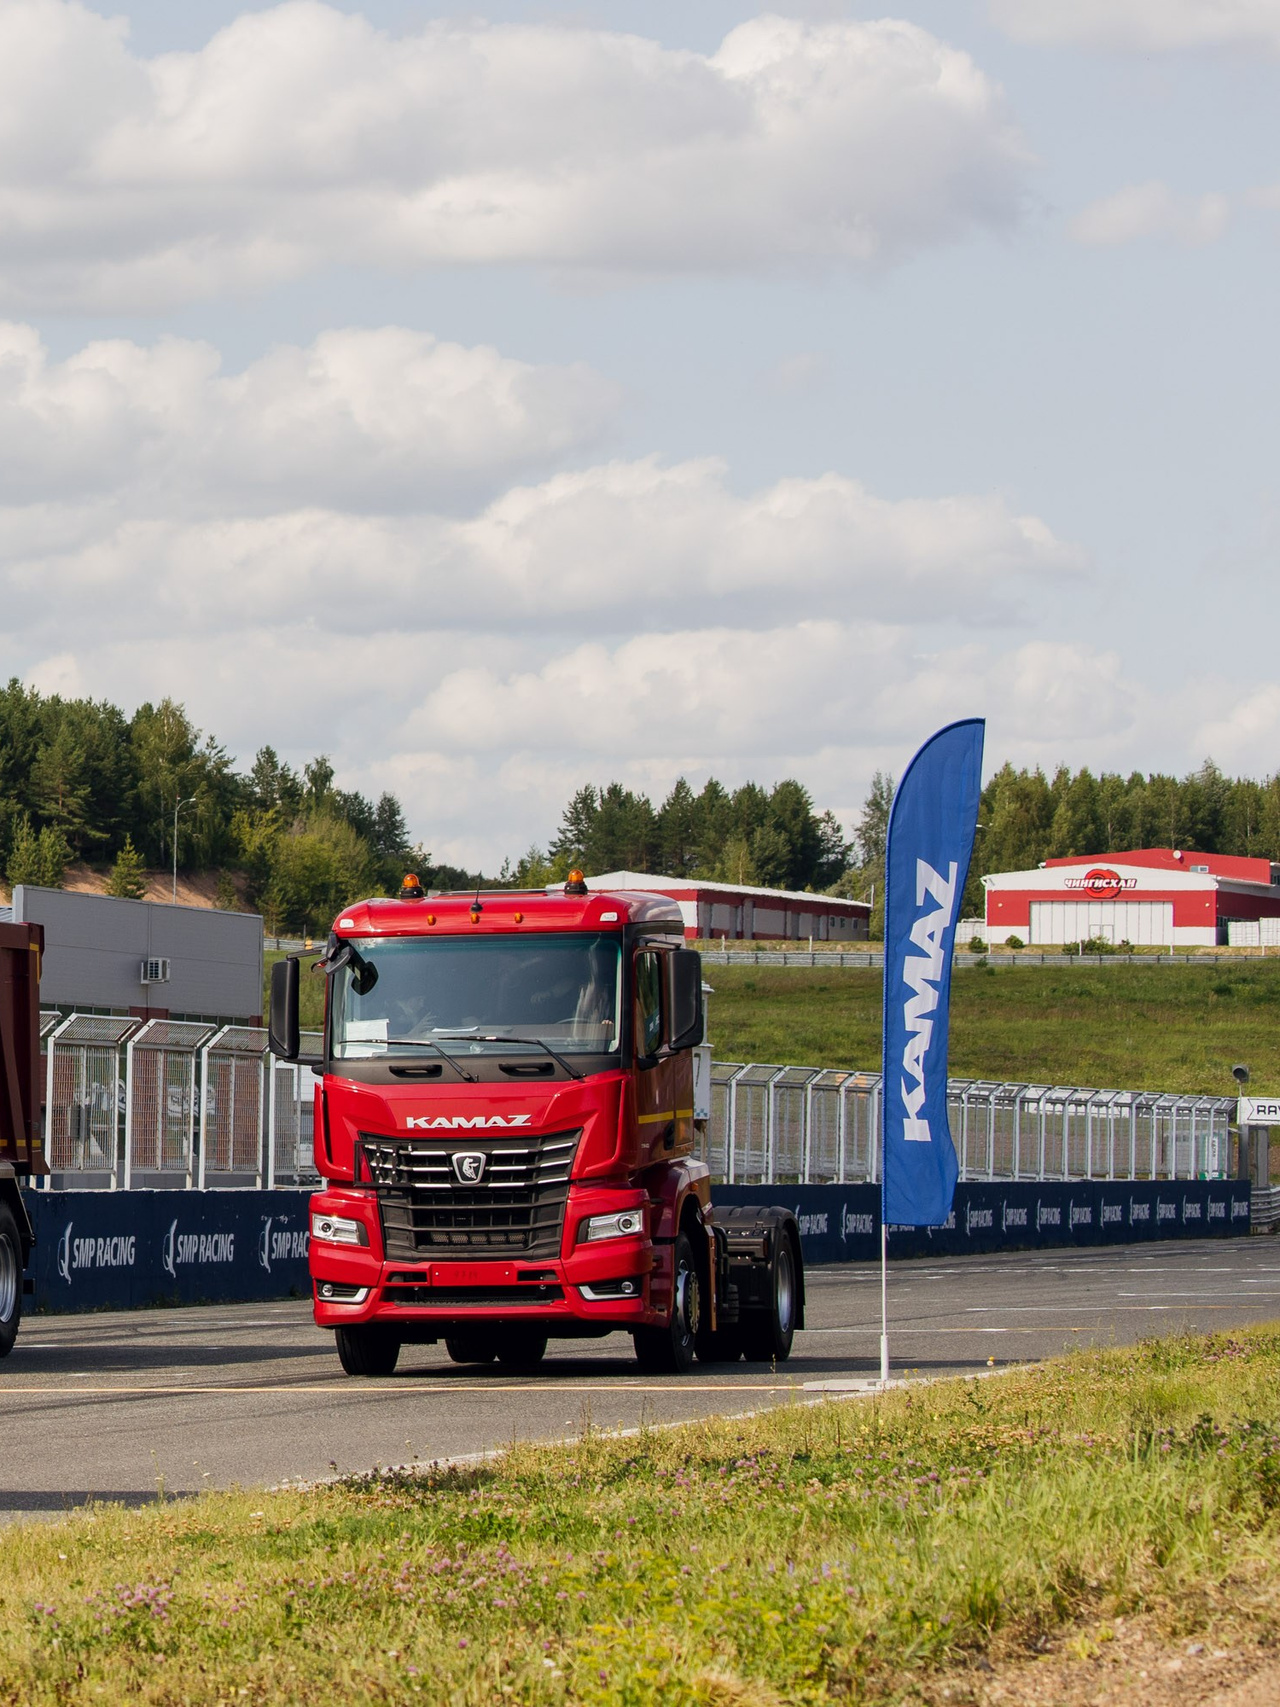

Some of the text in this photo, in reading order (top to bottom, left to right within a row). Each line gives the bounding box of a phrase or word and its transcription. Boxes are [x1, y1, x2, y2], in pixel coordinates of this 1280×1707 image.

[1064, 879, 1137, 888] ЧИНГИСХАН
[901, 858, 958, 1142] KAMAZ
[406, 1115, 531, 1129] KAMAZ
[1257, 1105, 1280, 1115] RA
[72, 1236, 136, 1268] SMP RACING
[176, 1233, 234, 1263] SMP RACING
[271, 1232, 291, 1259] SMP
